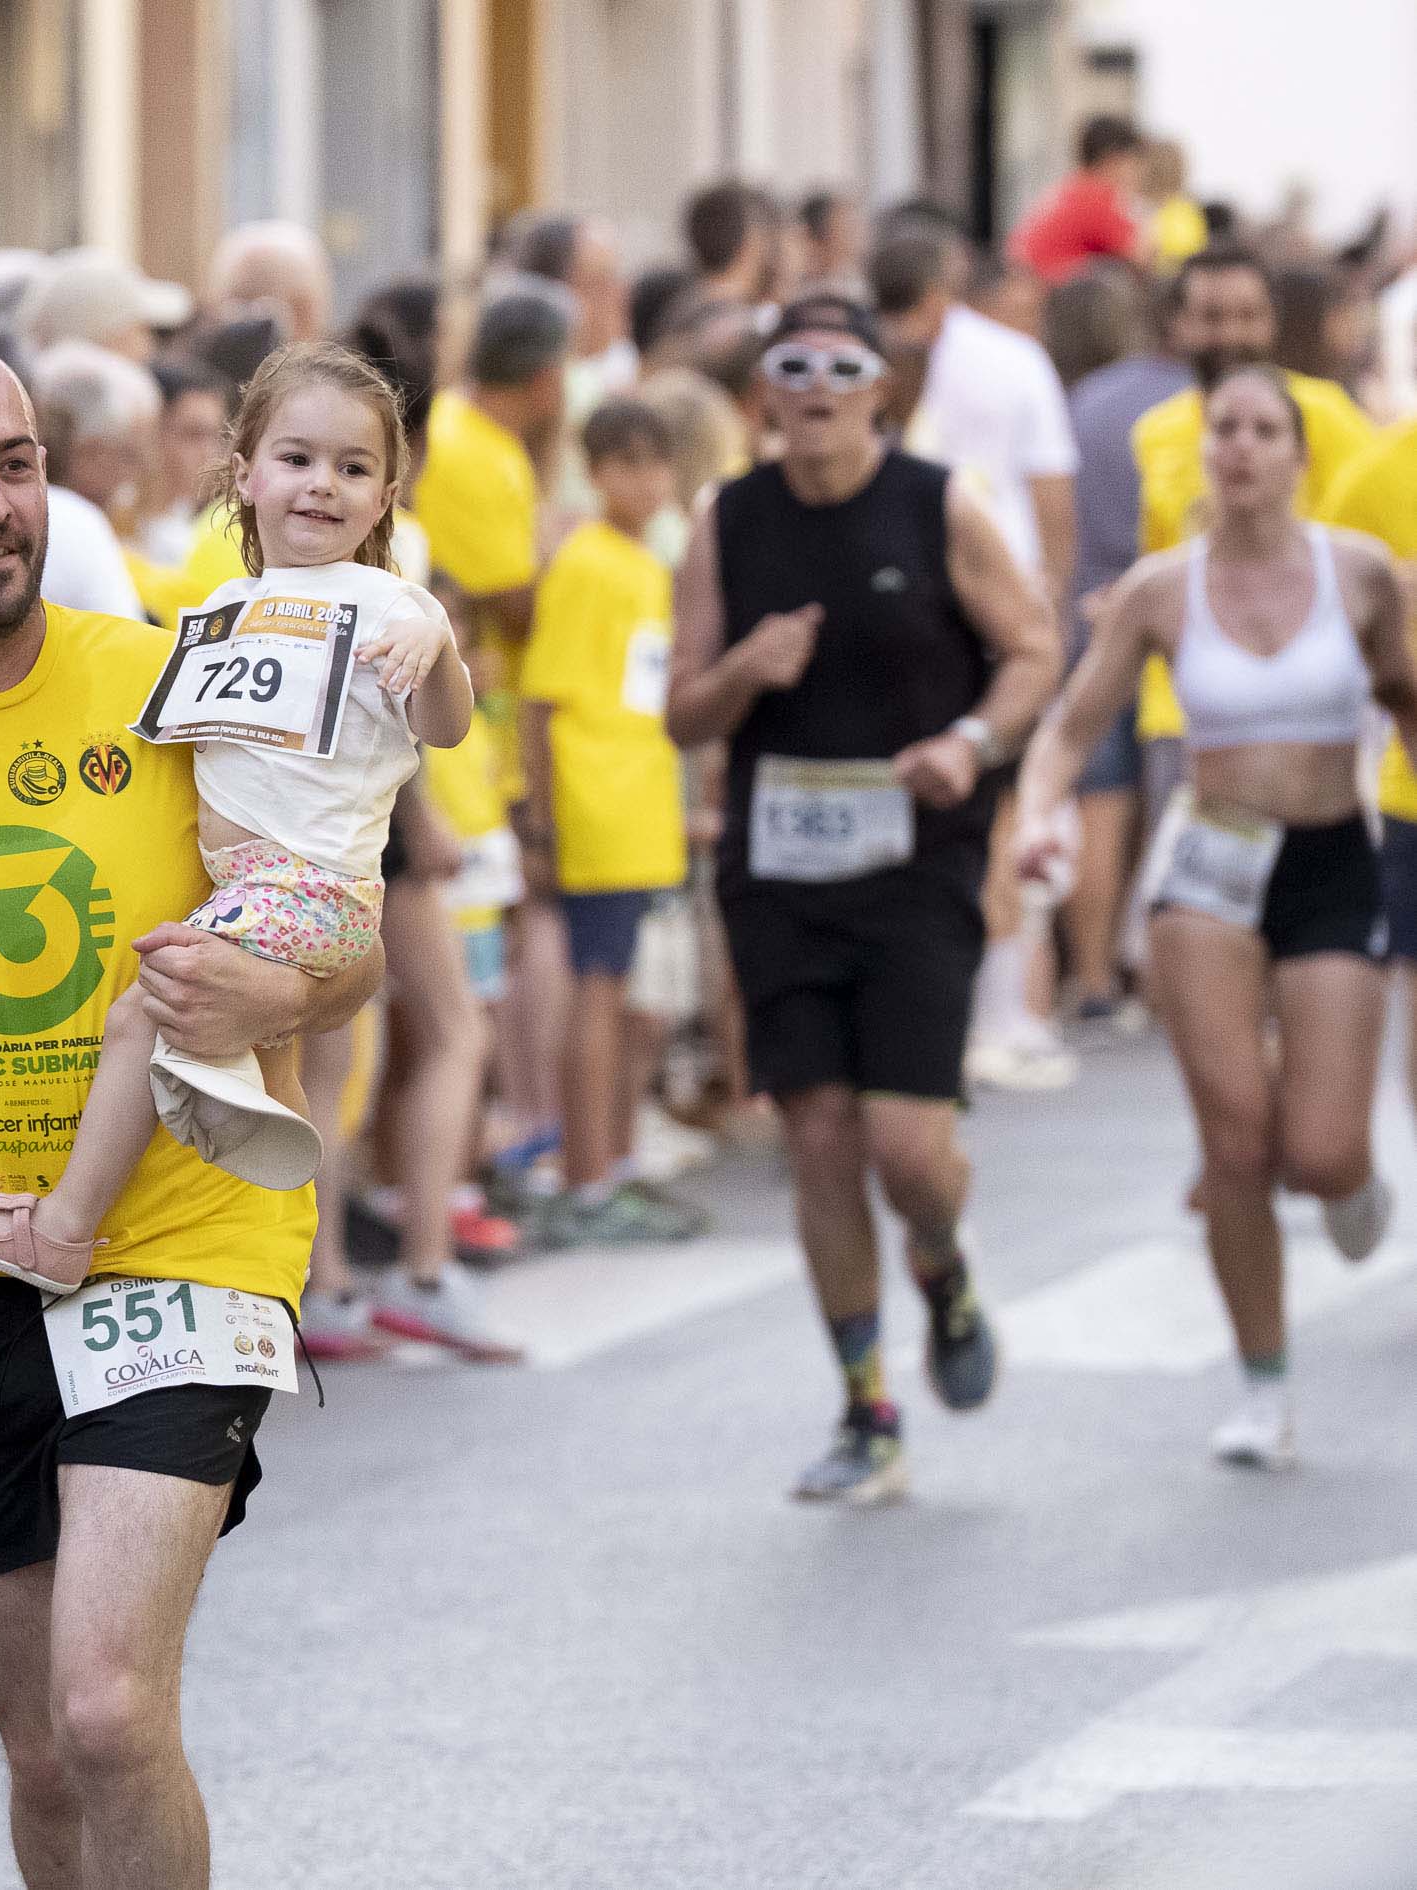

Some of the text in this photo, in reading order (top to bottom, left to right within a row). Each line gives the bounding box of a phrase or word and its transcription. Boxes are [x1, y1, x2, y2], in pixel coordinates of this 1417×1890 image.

[262, 602, 353, 624] 19 ABRIL 2026
[187, 617, 207, 637] 5K
[195, 656, 283, 702] 729
[35, 1040, 59, 1050] PER
[62, 1036, 104, 1048] PARELL
[12, 1051, 101, 1076] SUBMA
[24, 1077, 69, 1086] MANUEL
[28, 1110, 82, 1136] infant
[82, 1283, 197, 1352] 551
[105, 1348, 204, 1384] COVALCA
[107, 1368, 207, 1397] COMERCIAL DE CARPINTERIA
